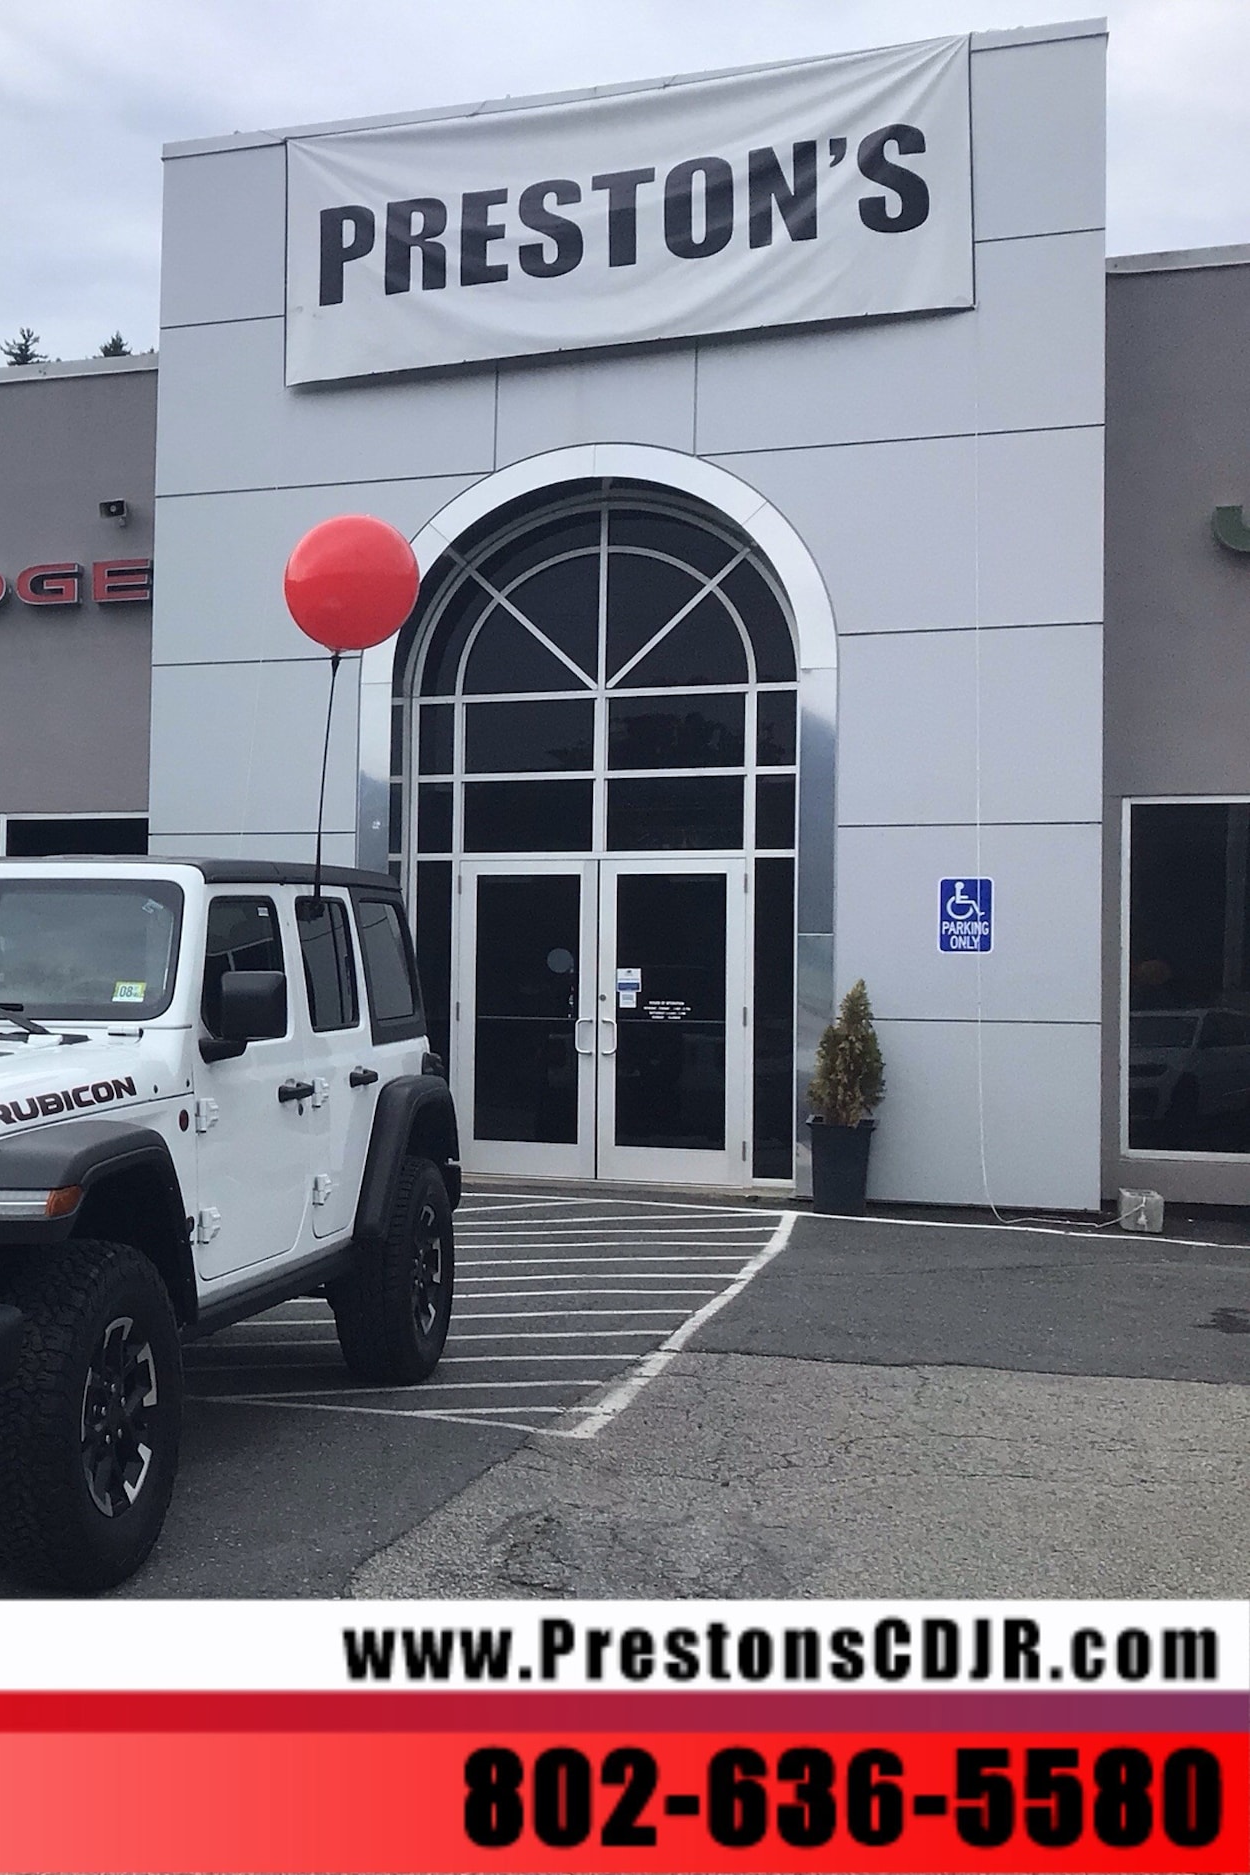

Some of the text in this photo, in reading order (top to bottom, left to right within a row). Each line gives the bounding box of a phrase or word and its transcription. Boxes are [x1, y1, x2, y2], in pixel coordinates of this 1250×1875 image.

[319, 123, 930, 306] PRESTON'S
[942, 921, 989, 935] PARKING
[950, 936, 980, 949] ONLY
[119, 985, 134, 998] 08
